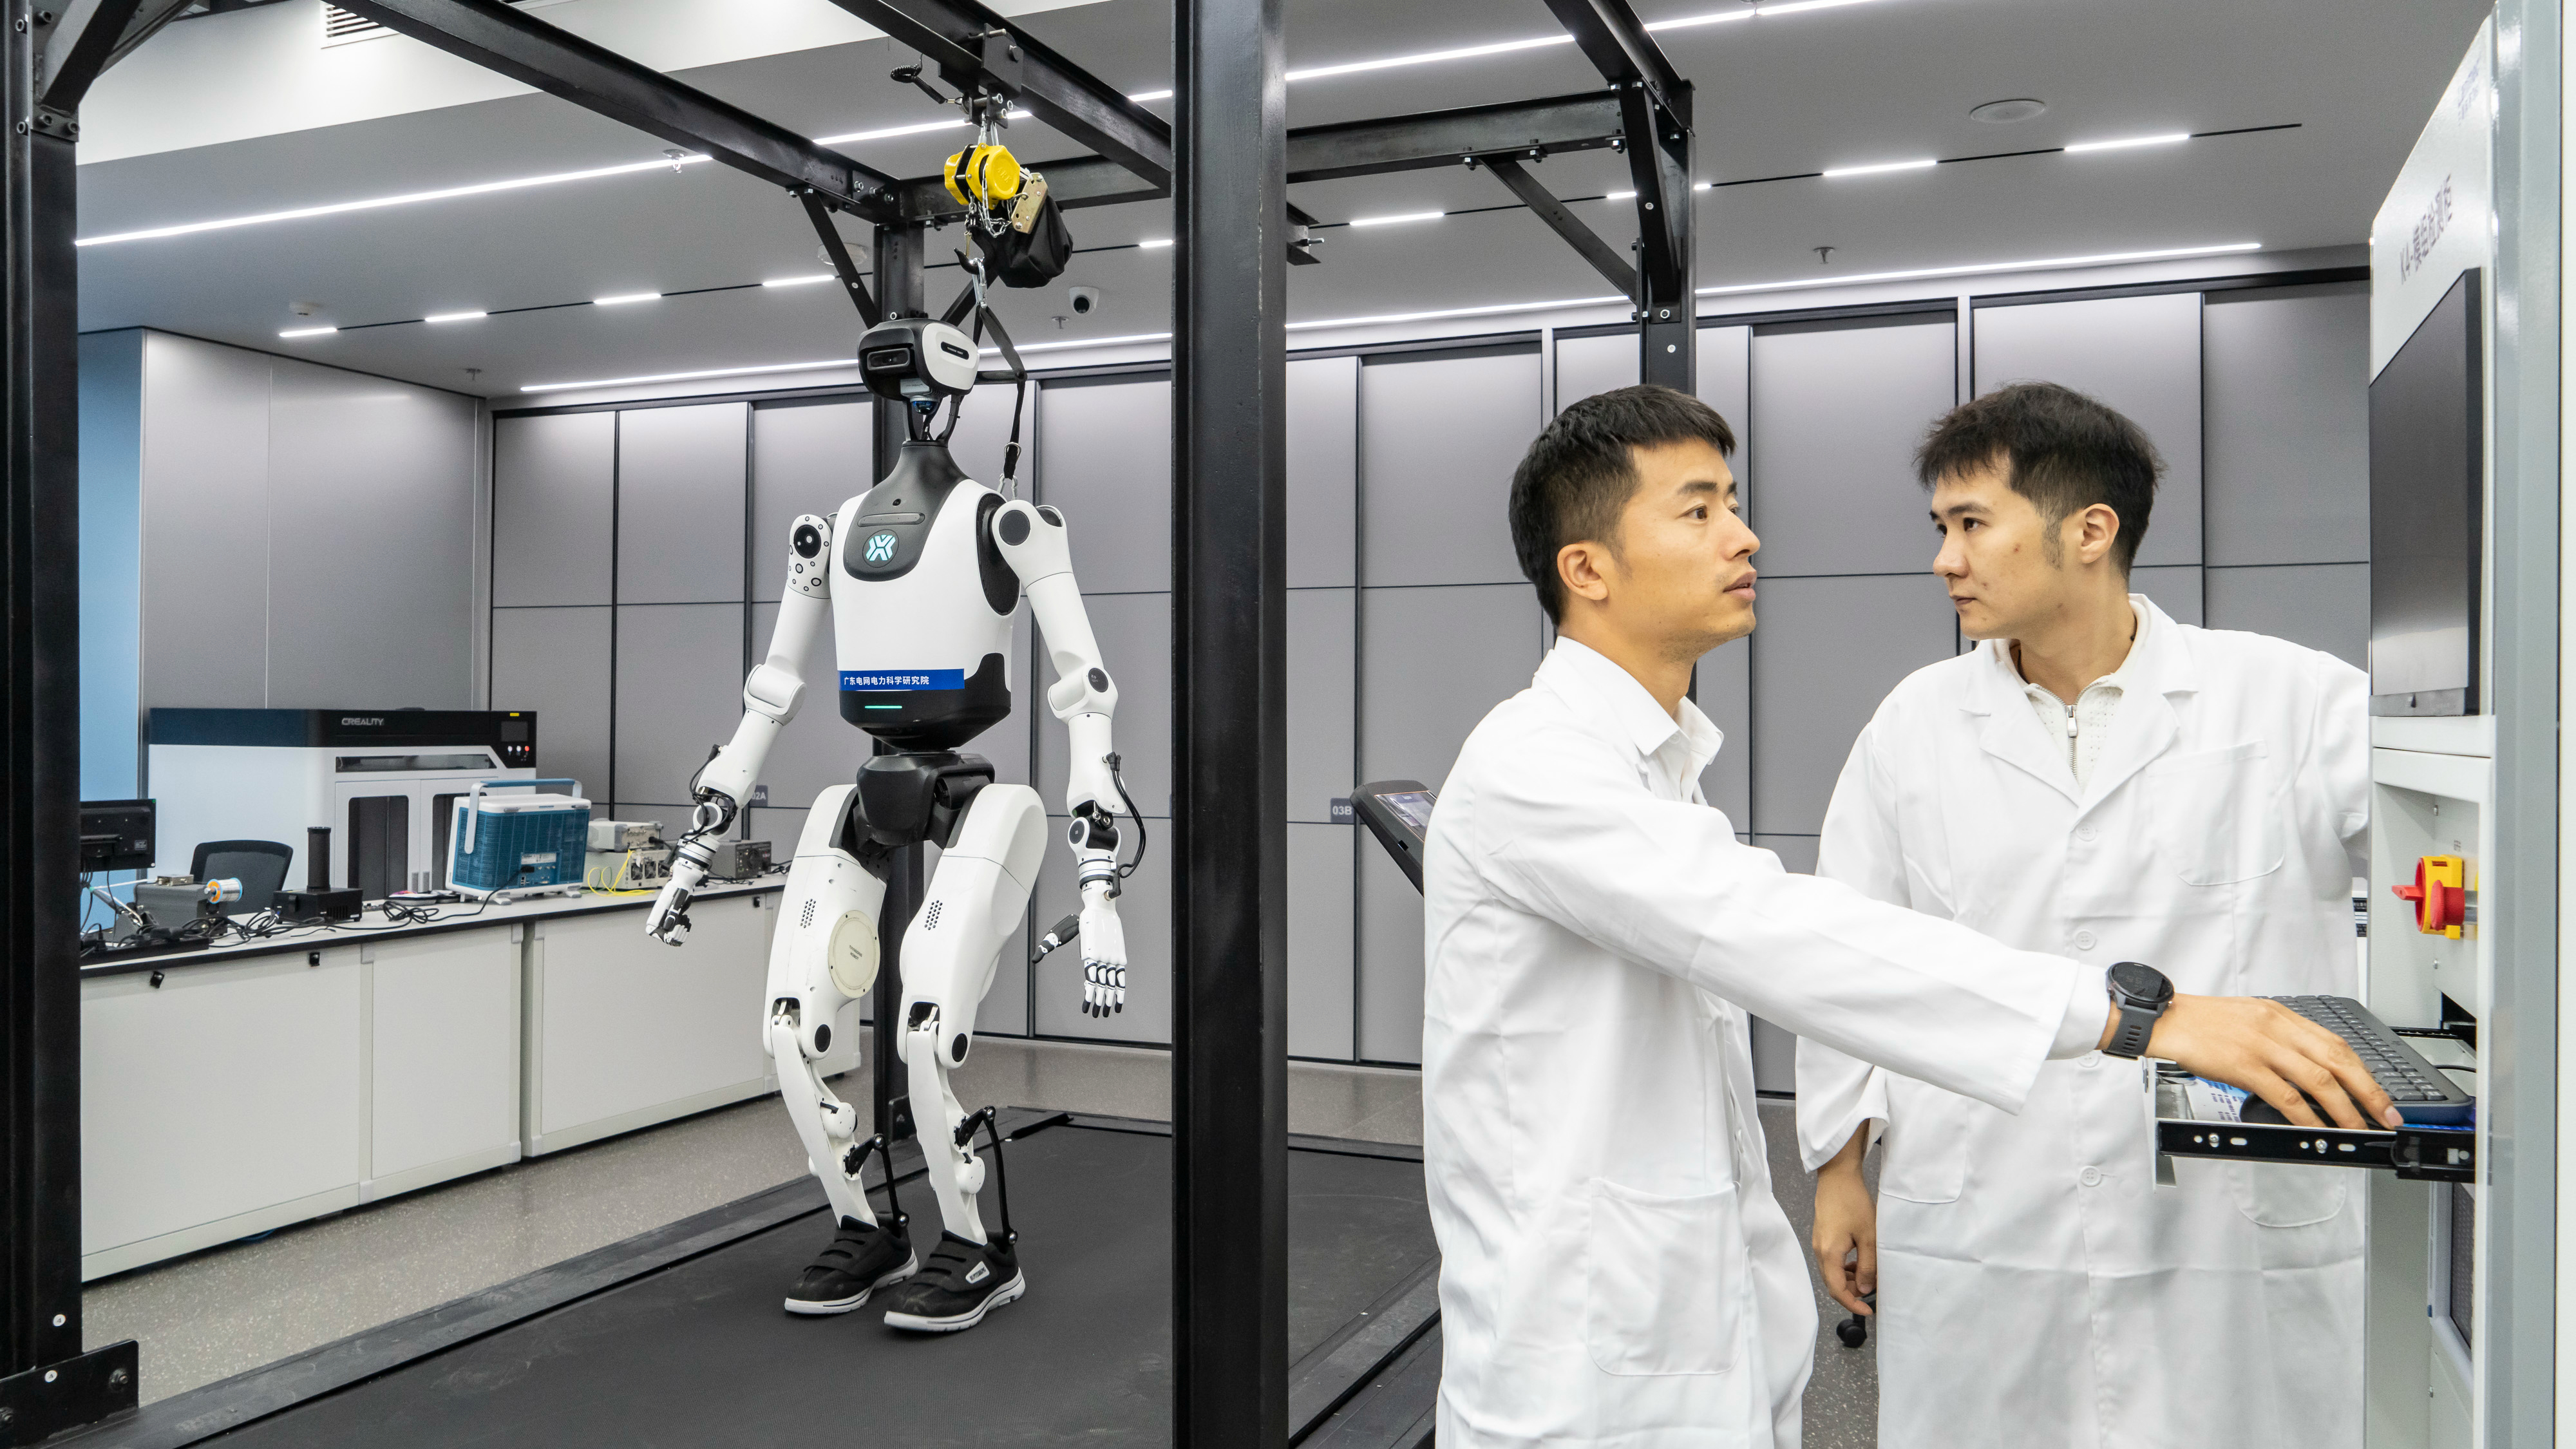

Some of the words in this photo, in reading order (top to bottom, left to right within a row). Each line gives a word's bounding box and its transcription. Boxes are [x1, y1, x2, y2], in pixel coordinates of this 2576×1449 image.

[844, 676, 930, 686] 广东电网电力科学研究院
[341, 717, 384, 726] CREALITY
[1332, 806, 1352, 815] 03B
